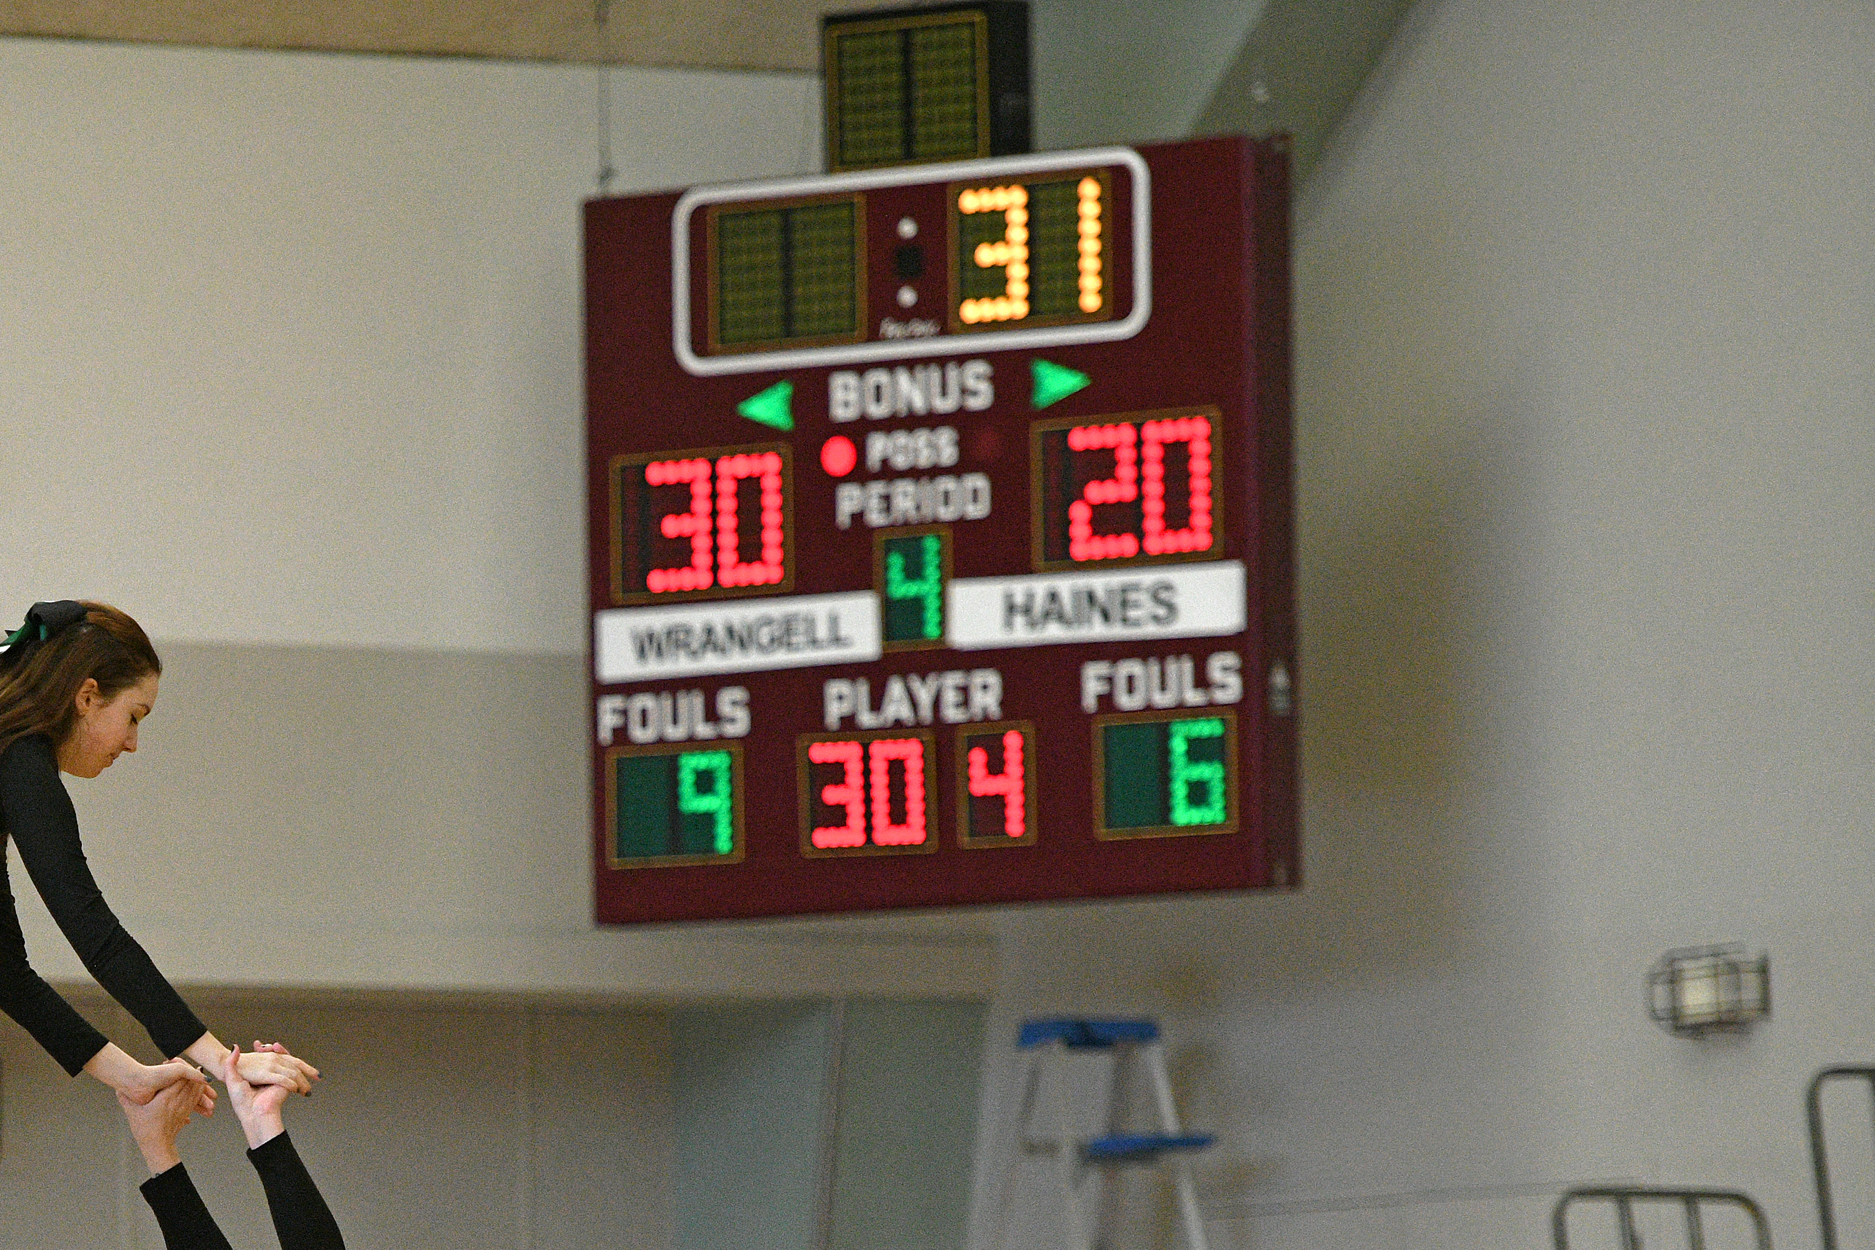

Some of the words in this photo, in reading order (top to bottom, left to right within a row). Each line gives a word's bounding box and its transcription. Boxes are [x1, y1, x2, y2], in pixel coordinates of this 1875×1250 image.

[959, 177, 1102, 324] 31
[828, 361, 995, 423] BONUS
[865, 427, 960, 472] POSS
[836, 477, 992, 529] PERIOD
[1067, 416, 1213, 562] 20
[644, 452, 785, 593] 30
[885, 533, 942, 641] 4
[1003, 582, 1179, 633] HAINES
[632, 605, 853, 666] WRANGELL
[823, 669, 1003, 730] PLAYER
[1081, 652, 1244, 714] FOULS
[597, 686, 751, 746] FOULS
[678, 750, 733, 855] 9
[808, 737, 927, 850] 30
[967, 729, 1026, 838] 4
[1168, 717, 1227, 827] 6
